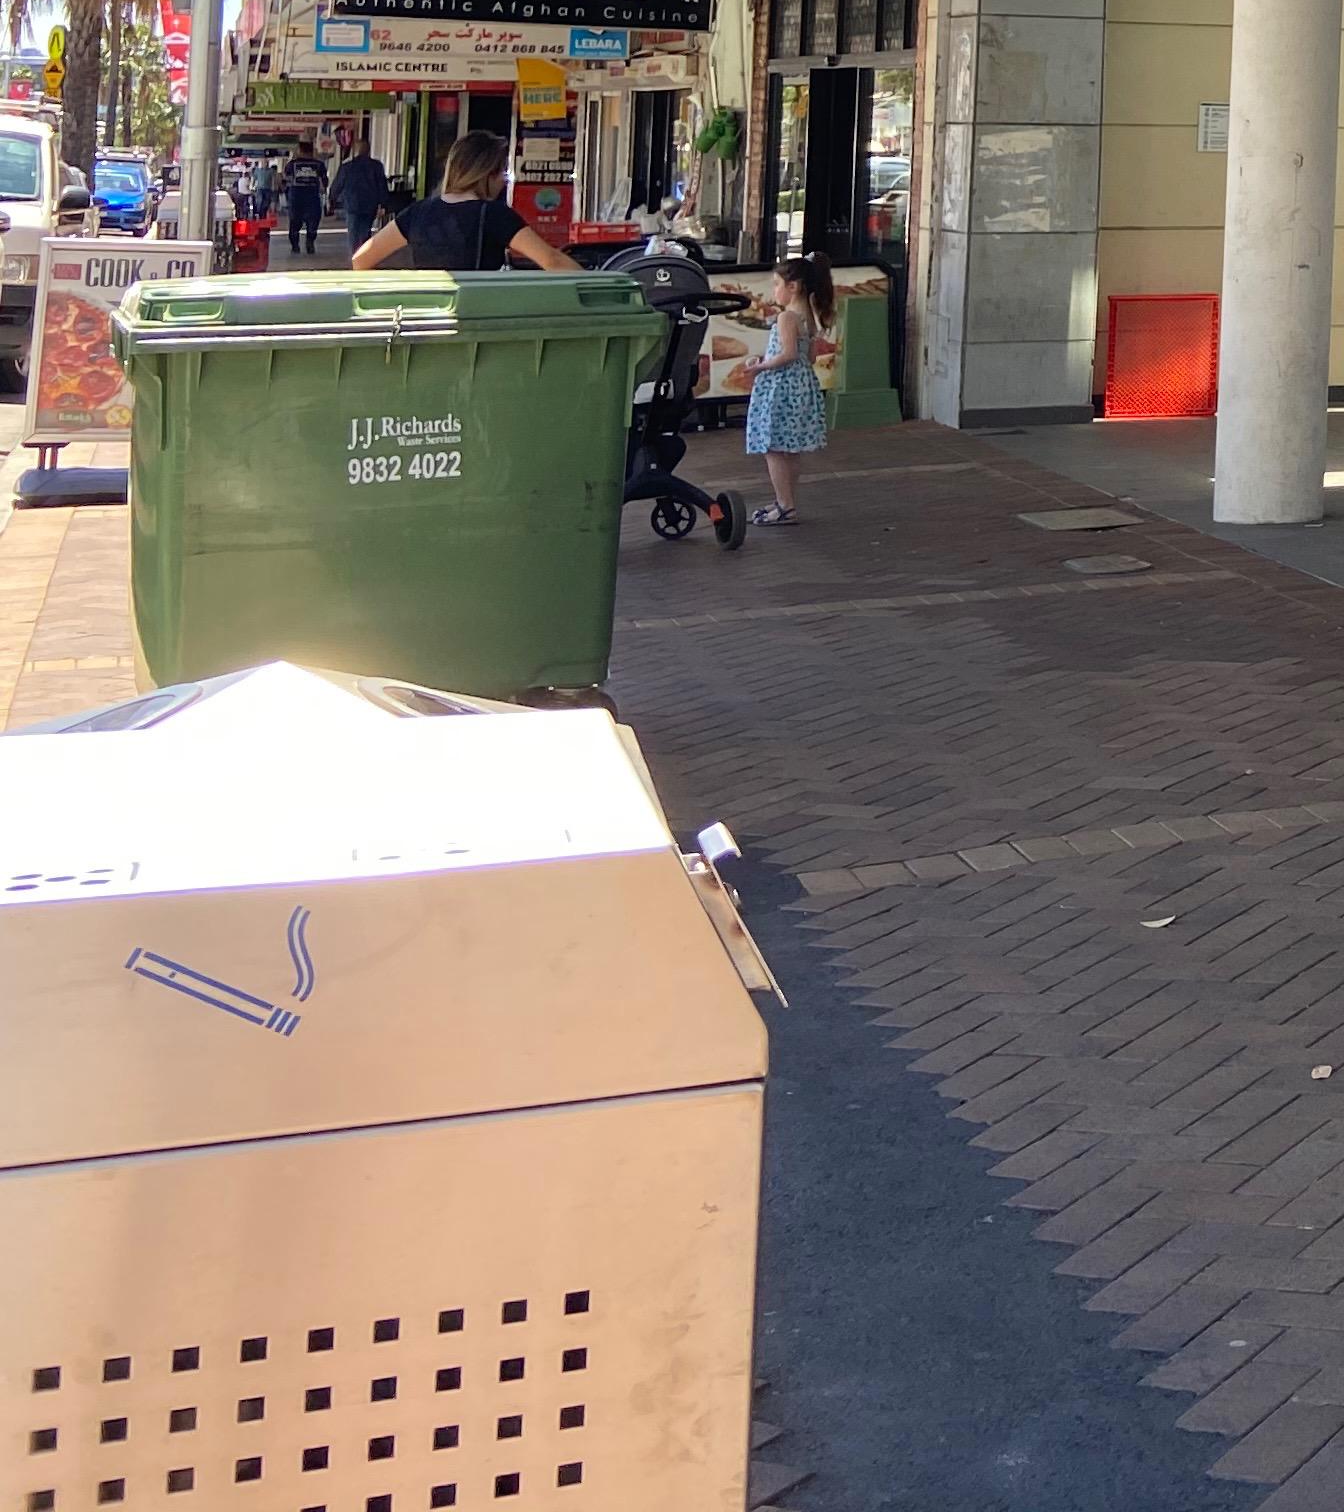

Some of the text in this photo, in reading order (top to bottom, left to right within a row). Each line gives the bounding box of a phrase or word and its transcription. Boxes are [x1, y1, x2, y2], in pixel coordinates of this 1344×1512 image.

[492, 0, 585, 18] Afghan
[603, 6, 698, 23] Cuisine
[416, 43, 450, 52] 4200
[474, 43, 508, 53] 0412
[575, 38, 622, 50] LEBARA
[336, 61, 392, 72] ISLAMIC
[395, 62, 448, 73] CENTRE
[85, 258, 144, 287] COOK
[397, 434, 462, 447] Waste Services
[347, 451, 462, 485] 9832 4022
